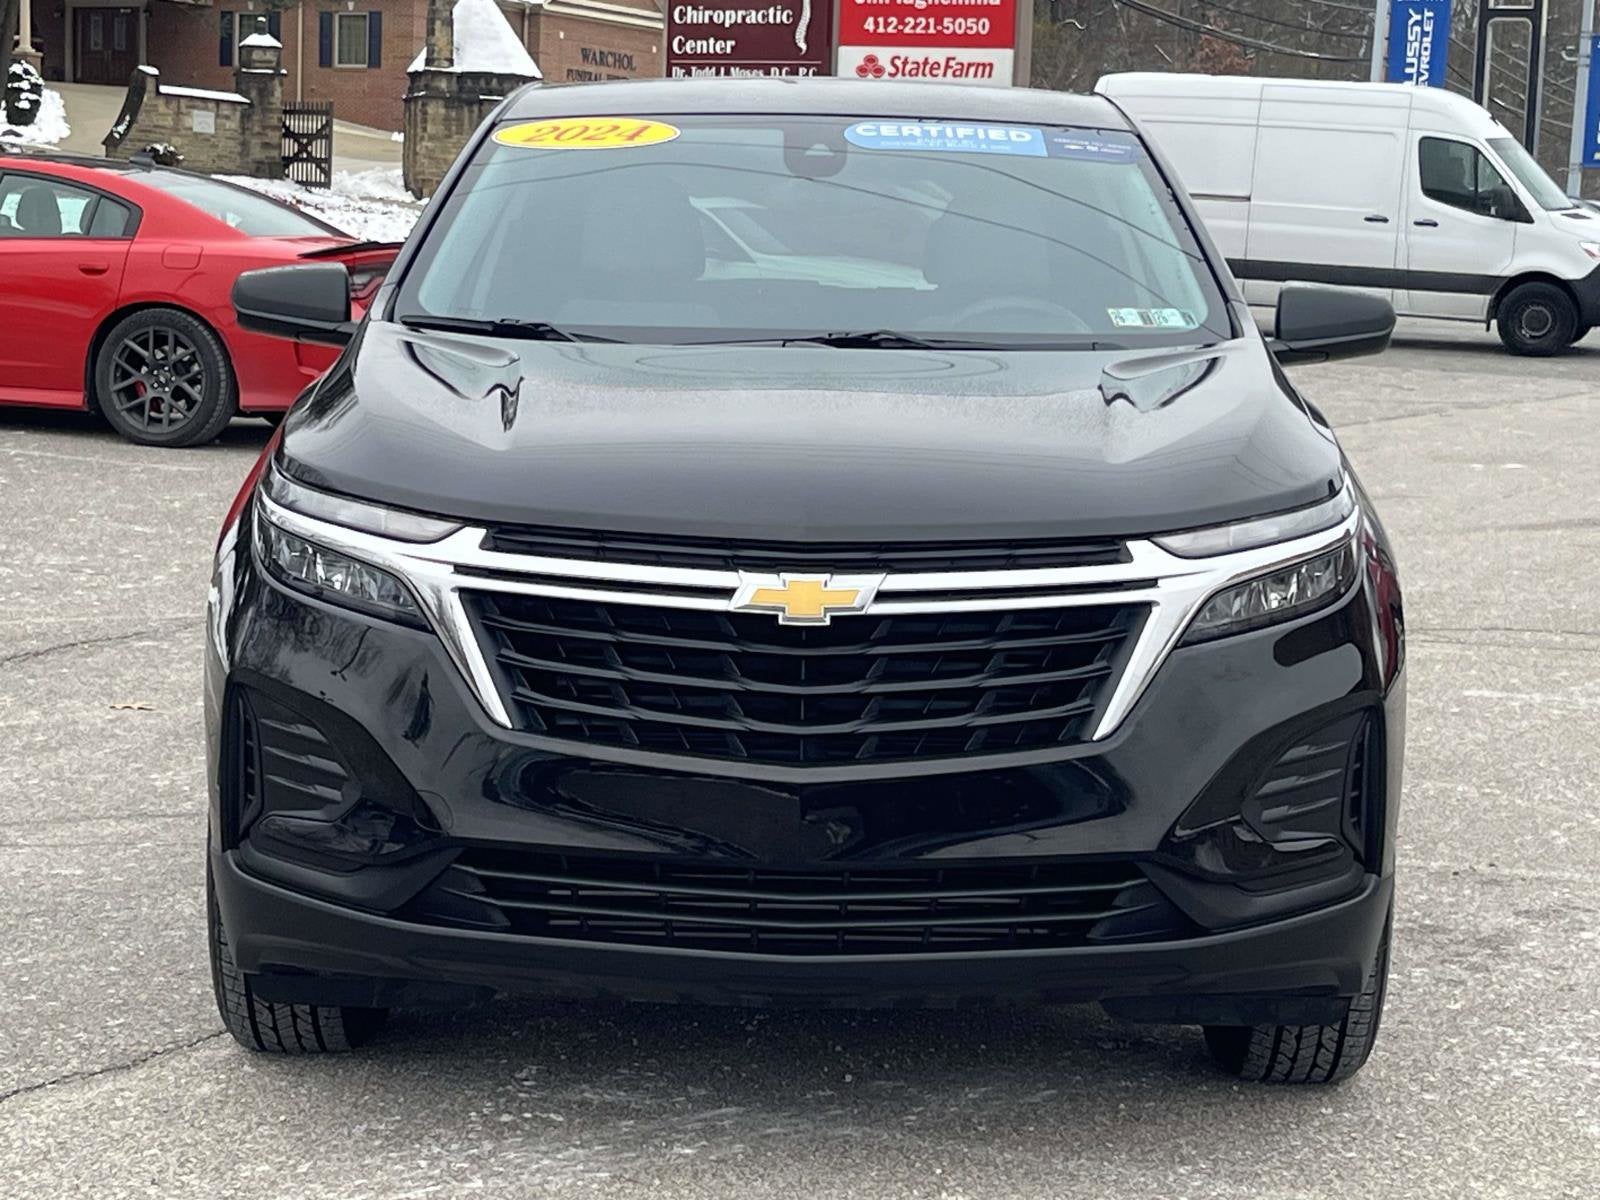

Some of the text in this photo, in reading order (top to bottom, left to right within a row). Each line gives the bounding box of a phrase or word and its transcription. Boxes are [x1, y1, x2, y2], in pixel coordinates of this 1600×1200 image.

[673, 5, 794, 28] Chiropractic
[863, 16, 991, 35] 412-221-5050
[672, 35, 736, 55] Center
[581, 47, 637, 72] WARCHOL
[522, 124, 652, 143] 2024
[855, 124, 1032, 142] CERTIFIED
